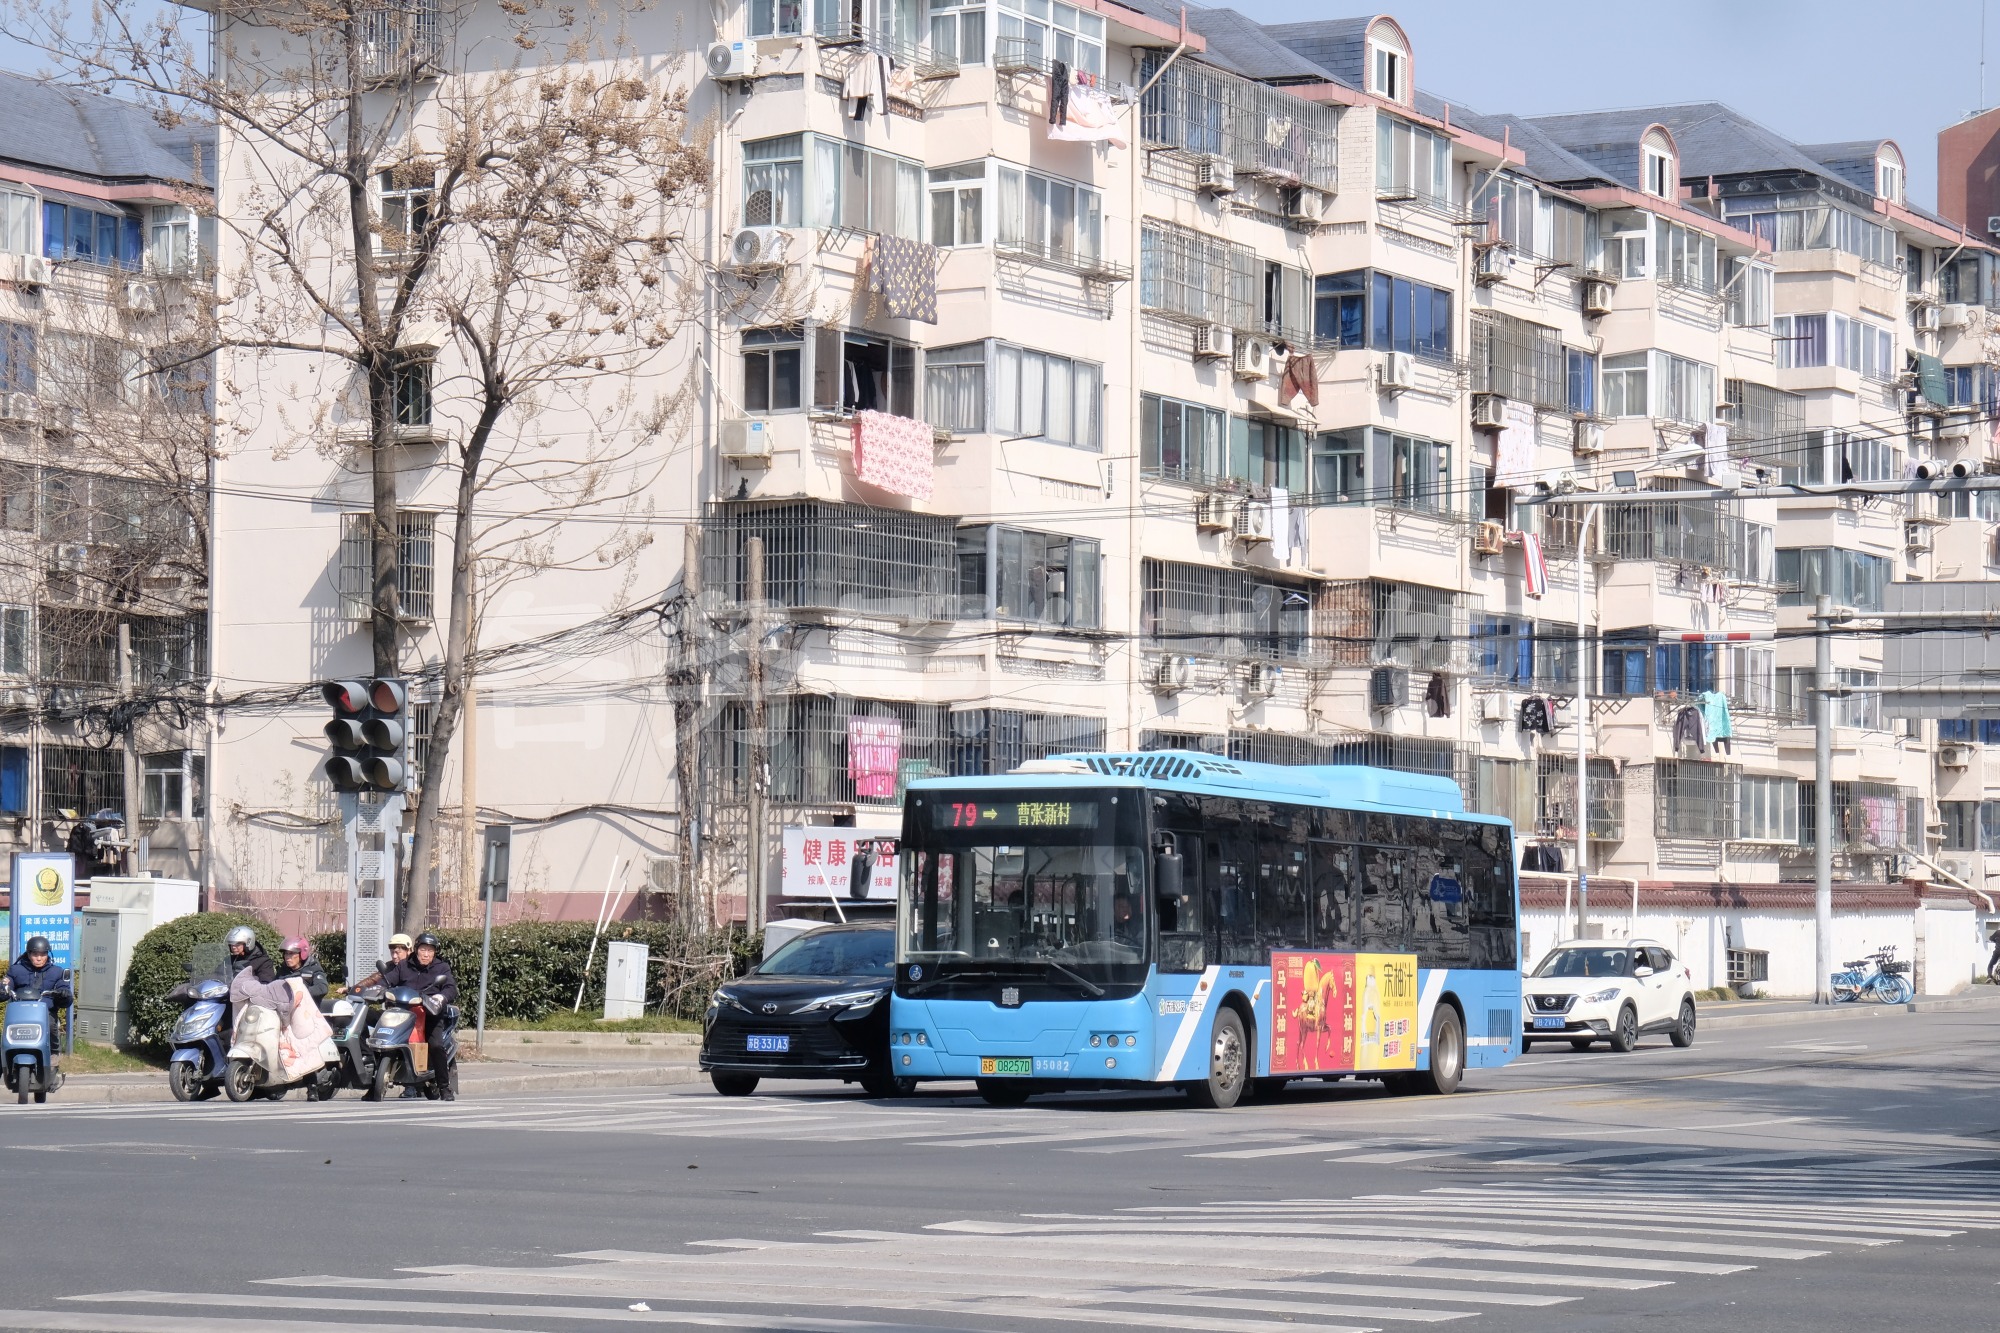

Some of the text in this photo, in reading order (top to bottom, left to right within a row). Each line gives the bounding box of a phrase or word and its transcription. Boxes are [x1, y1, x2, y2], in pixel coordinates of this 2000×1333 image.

[952, 802, 1072, 826] 79 曹张新村
[1036, 1060, 1069, 1071] 95082
